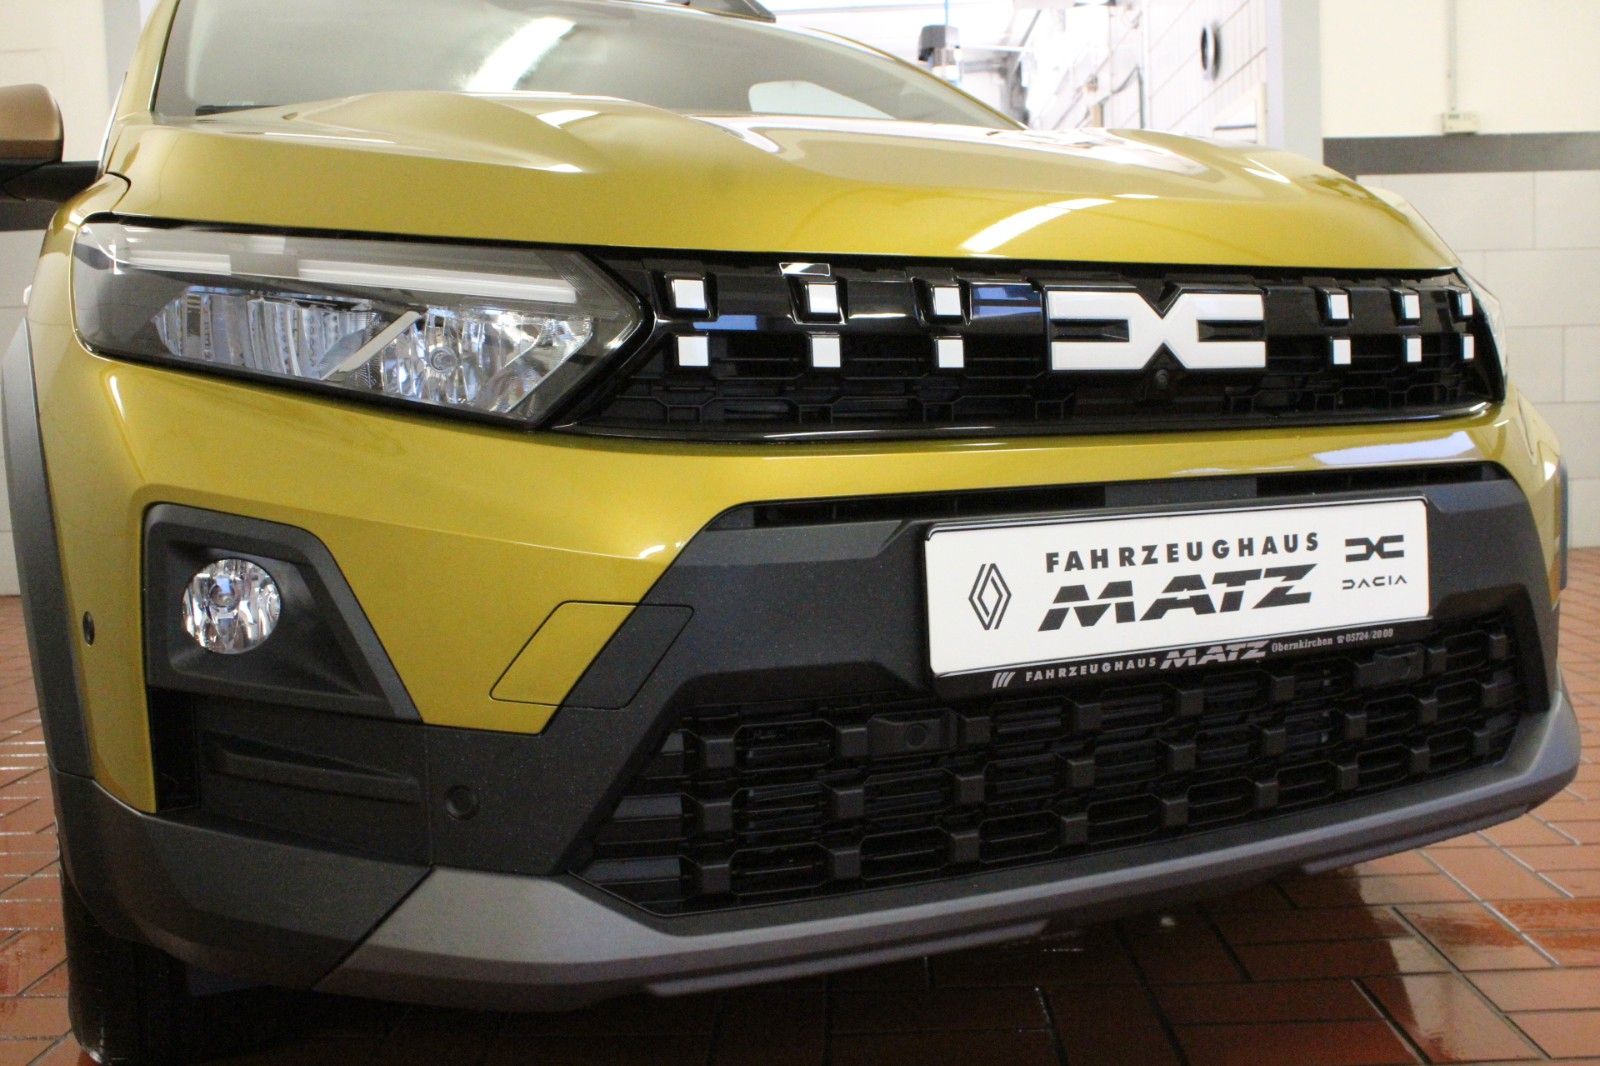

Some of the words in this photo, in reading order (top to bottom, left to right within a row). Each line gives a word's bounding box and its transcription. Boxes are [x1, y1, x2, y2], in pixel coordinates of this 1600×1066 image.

[1045, 532, 1319, 573] FAHRZEUGHAUS
[1037, 563, 1317, 632] MATZ
[1342, 574, 1407, 590] DACIA
[1025, 657, 1156, 682] FAHRZEUGHAUS
[1160, 640, 1270, 670] MATZ
